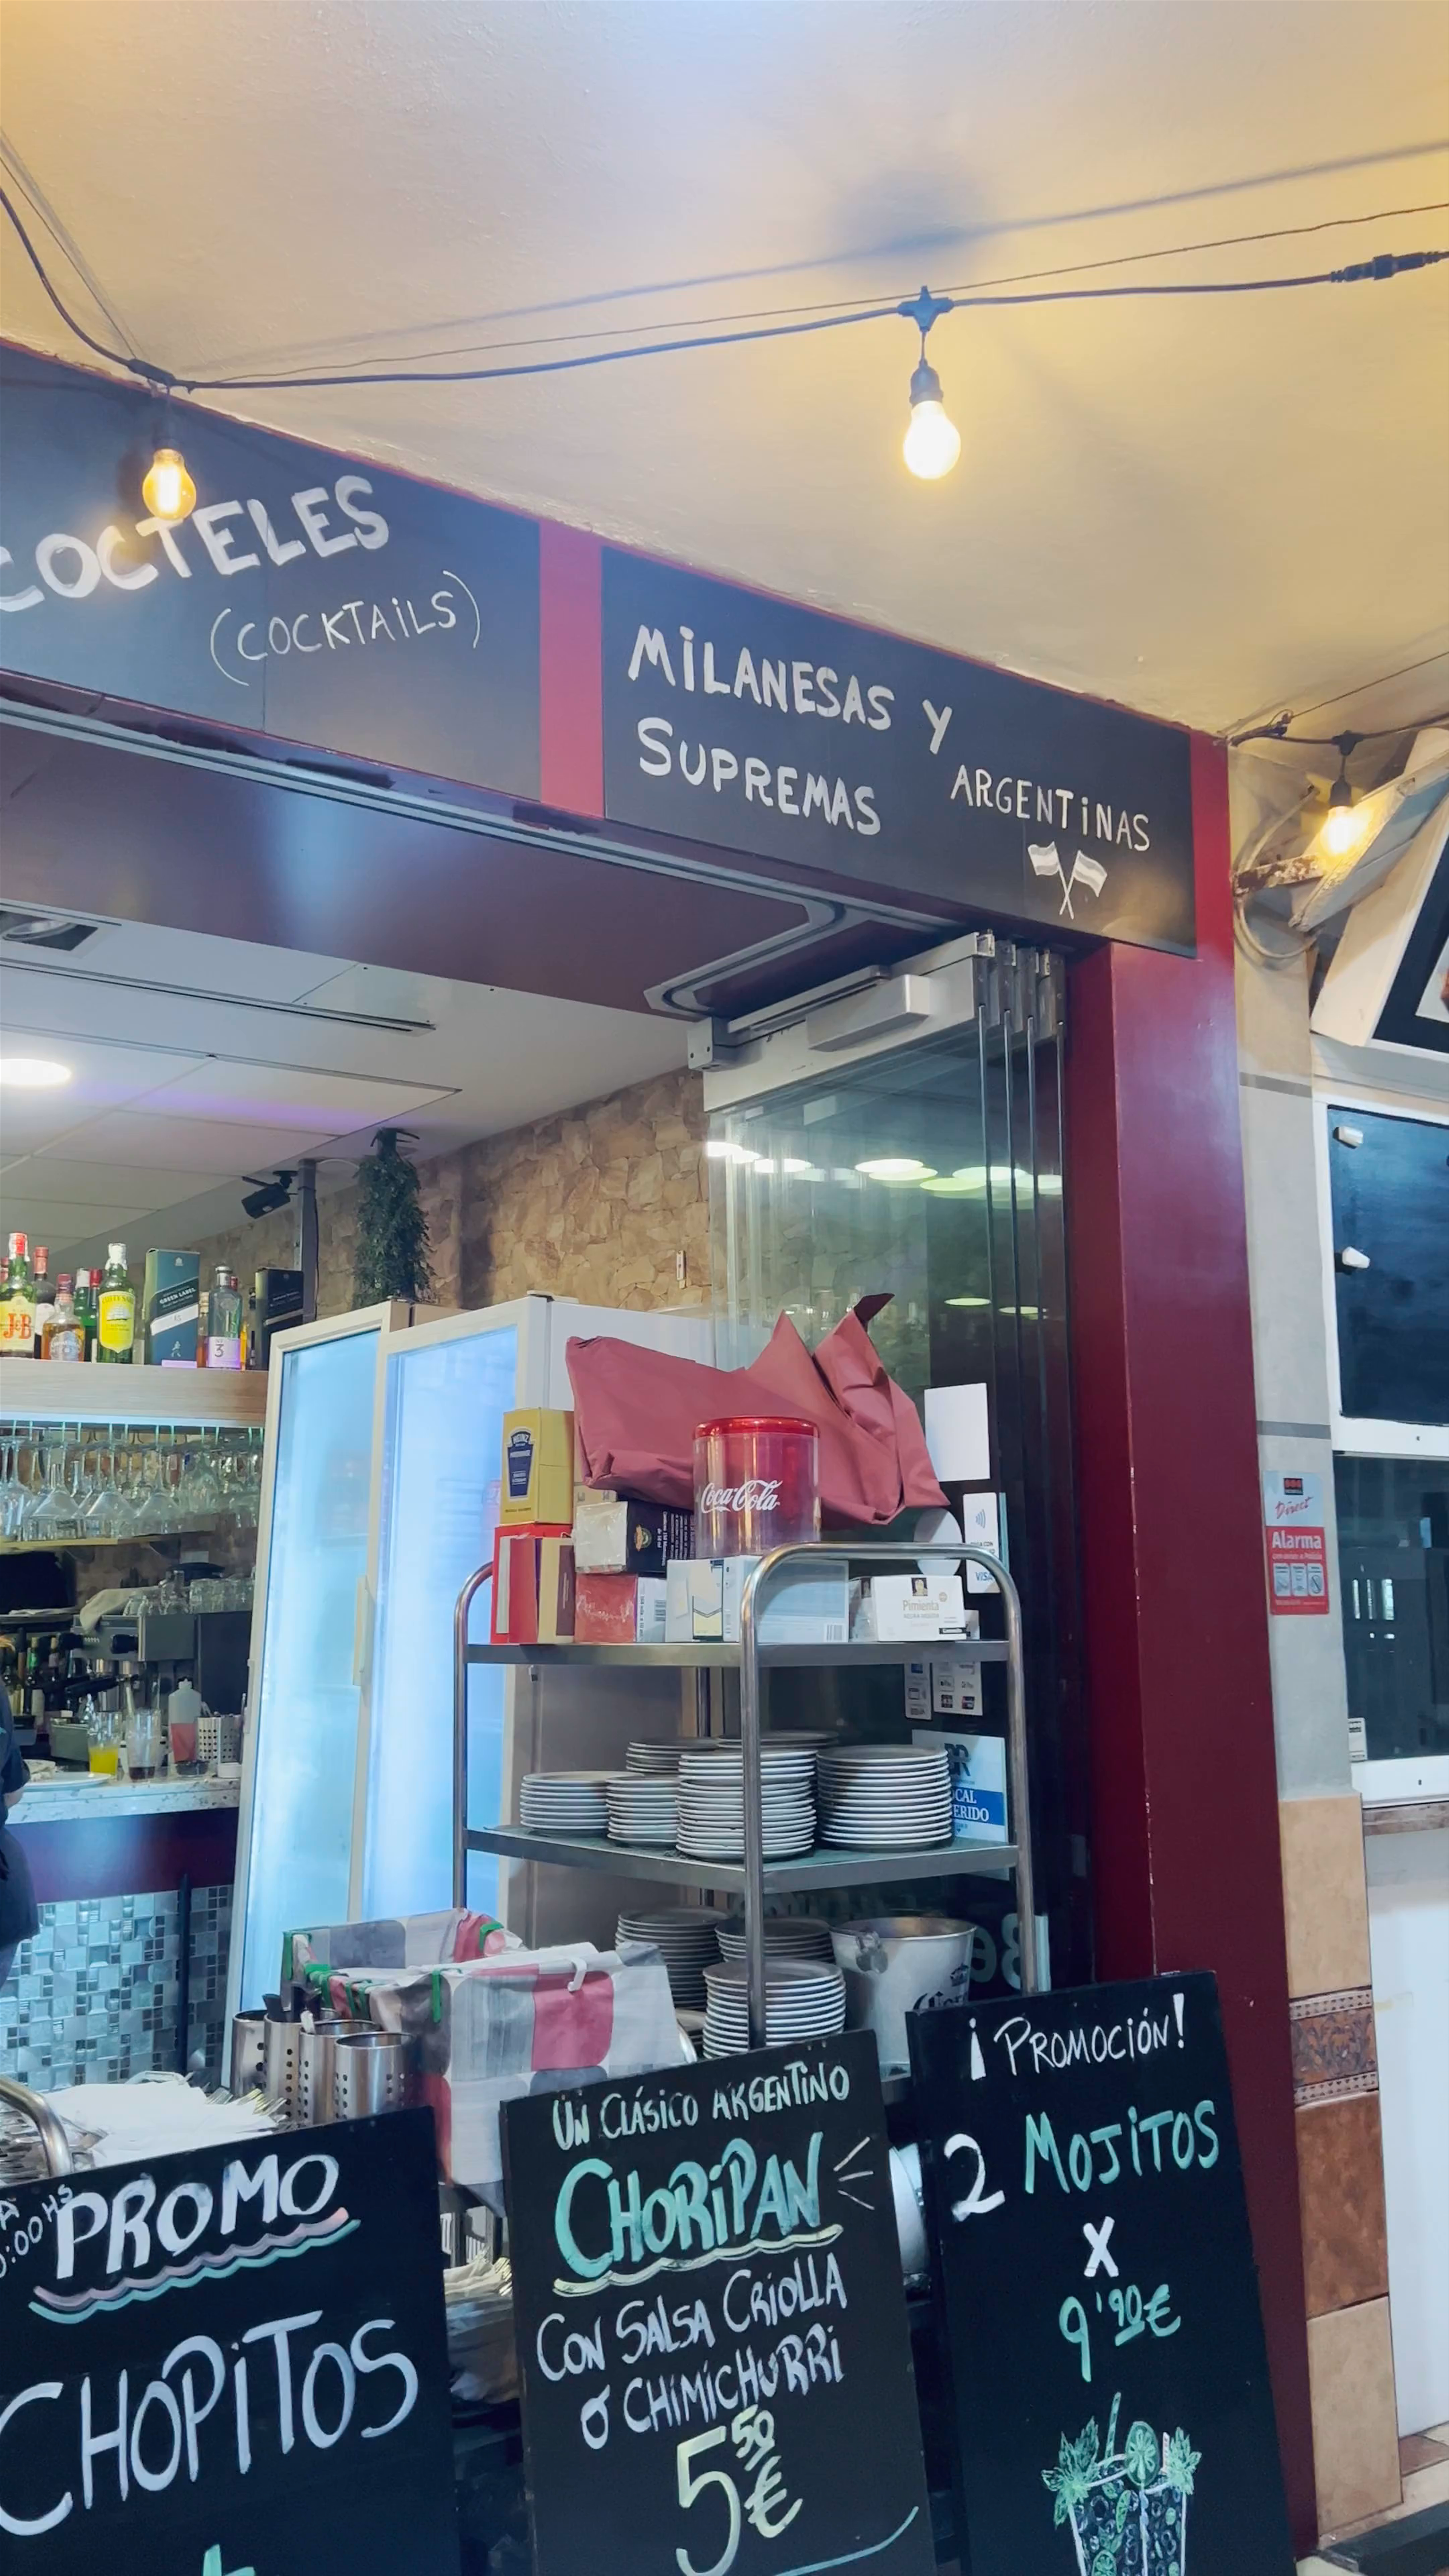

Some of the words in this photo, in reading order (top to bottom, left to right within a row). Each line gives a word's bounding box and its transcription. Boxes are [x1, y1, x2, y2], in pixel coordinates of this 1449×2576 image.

[0, 475, 389, 612] COCTELES
[922, 699, 952, 755] Y
[637, 717, 881, 835] SUPREMAS
[159, 1293, 178, 1304] GREEN
[178, 1287, 196, 1296] LABEL
[701, 1479, 782, 1513] Coca-Cola
[1275, 1496, 1314, 1519] Direct
[1271, 1530, 1322, 1549] Alarma
[902, 1599, 939, 1611] Pimienta
[952, 1788, 977, 1804] CAL
[953, 1805, 989, 1822] ERIDO
[943, 2133, 1006, 2222] 2
[56, 2154, 339, 2280] PROMO
[615, 2295, 715, 2364] SALSA
